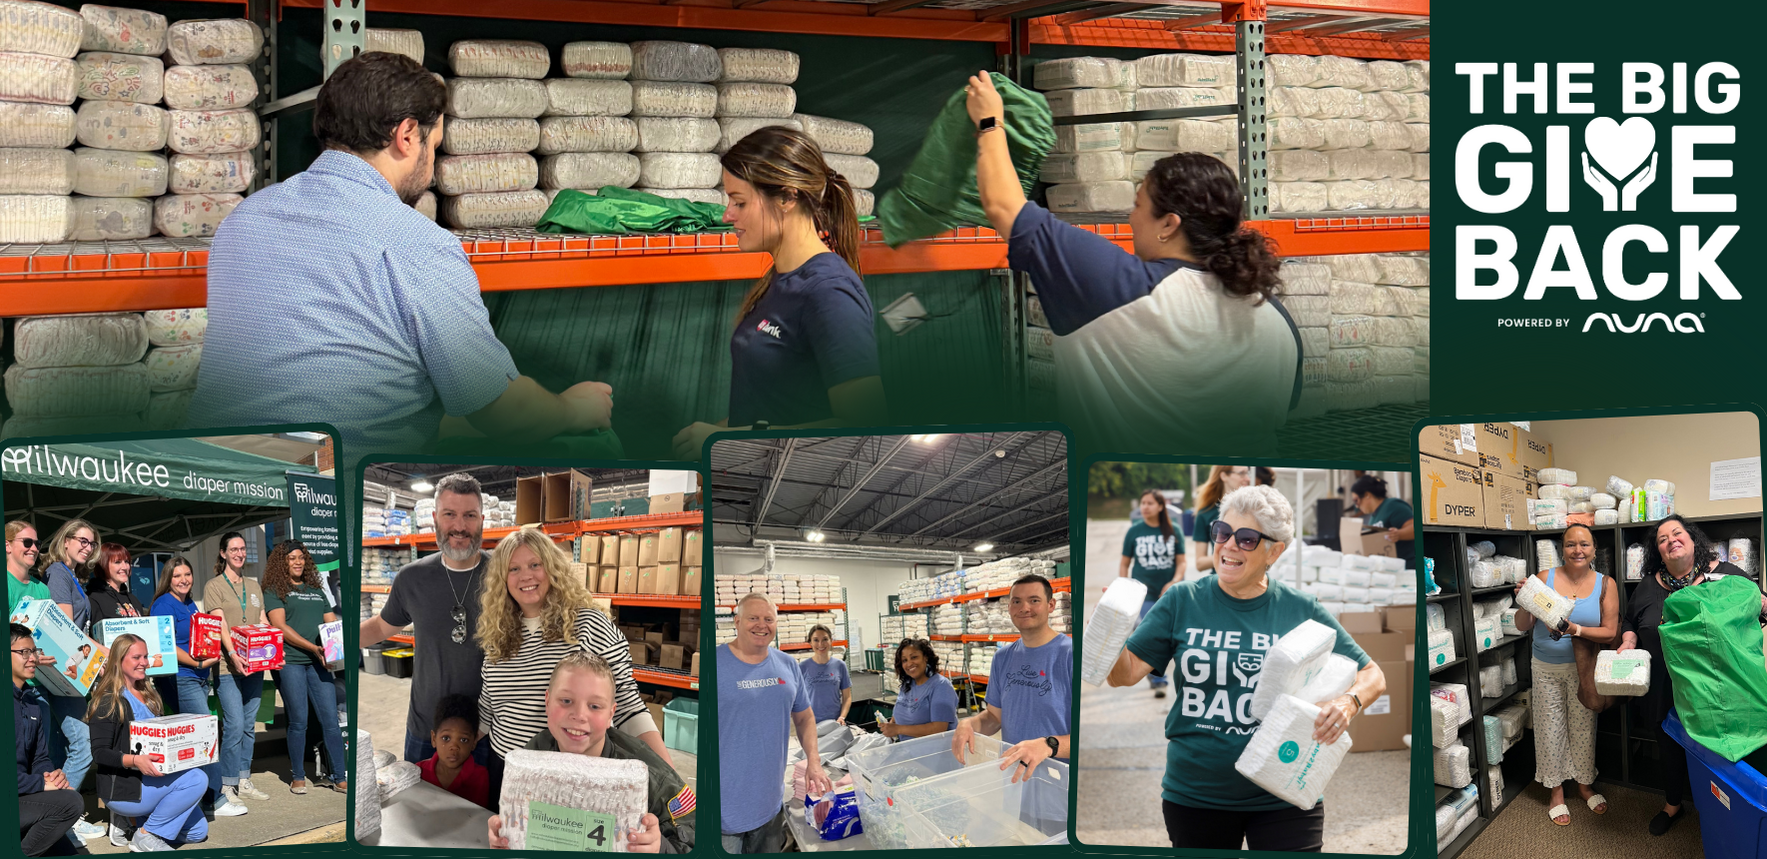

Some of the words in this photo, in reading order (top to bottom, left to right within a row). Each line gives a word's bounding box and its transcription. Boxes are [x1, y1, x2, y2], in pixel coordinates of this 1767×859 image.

[183, 470, 230, 495] diaper
[233, 481, 283, 500] mission
[311, 506, 333, 518] diaper
[1445, 504, 1476, 517] DYPER
[105, 619, 133, 627] Absorbent
[1186, 628, 1241, 649] THE
[1018, 664, 1039, 678] Live
[741, 678, 779, 689] GENEROUSLY
[1005, 672, 1052, 696] Generously
[130, 725, 166, 738] HUGGIES
[167, 724, 195, 737] HUGGIES
[531, 813, 584, 829] milwaukee
[542, 823, 560, 831] diaper
[561, 827, 583, 835] mission
[587, 824, 607, 847] 4
